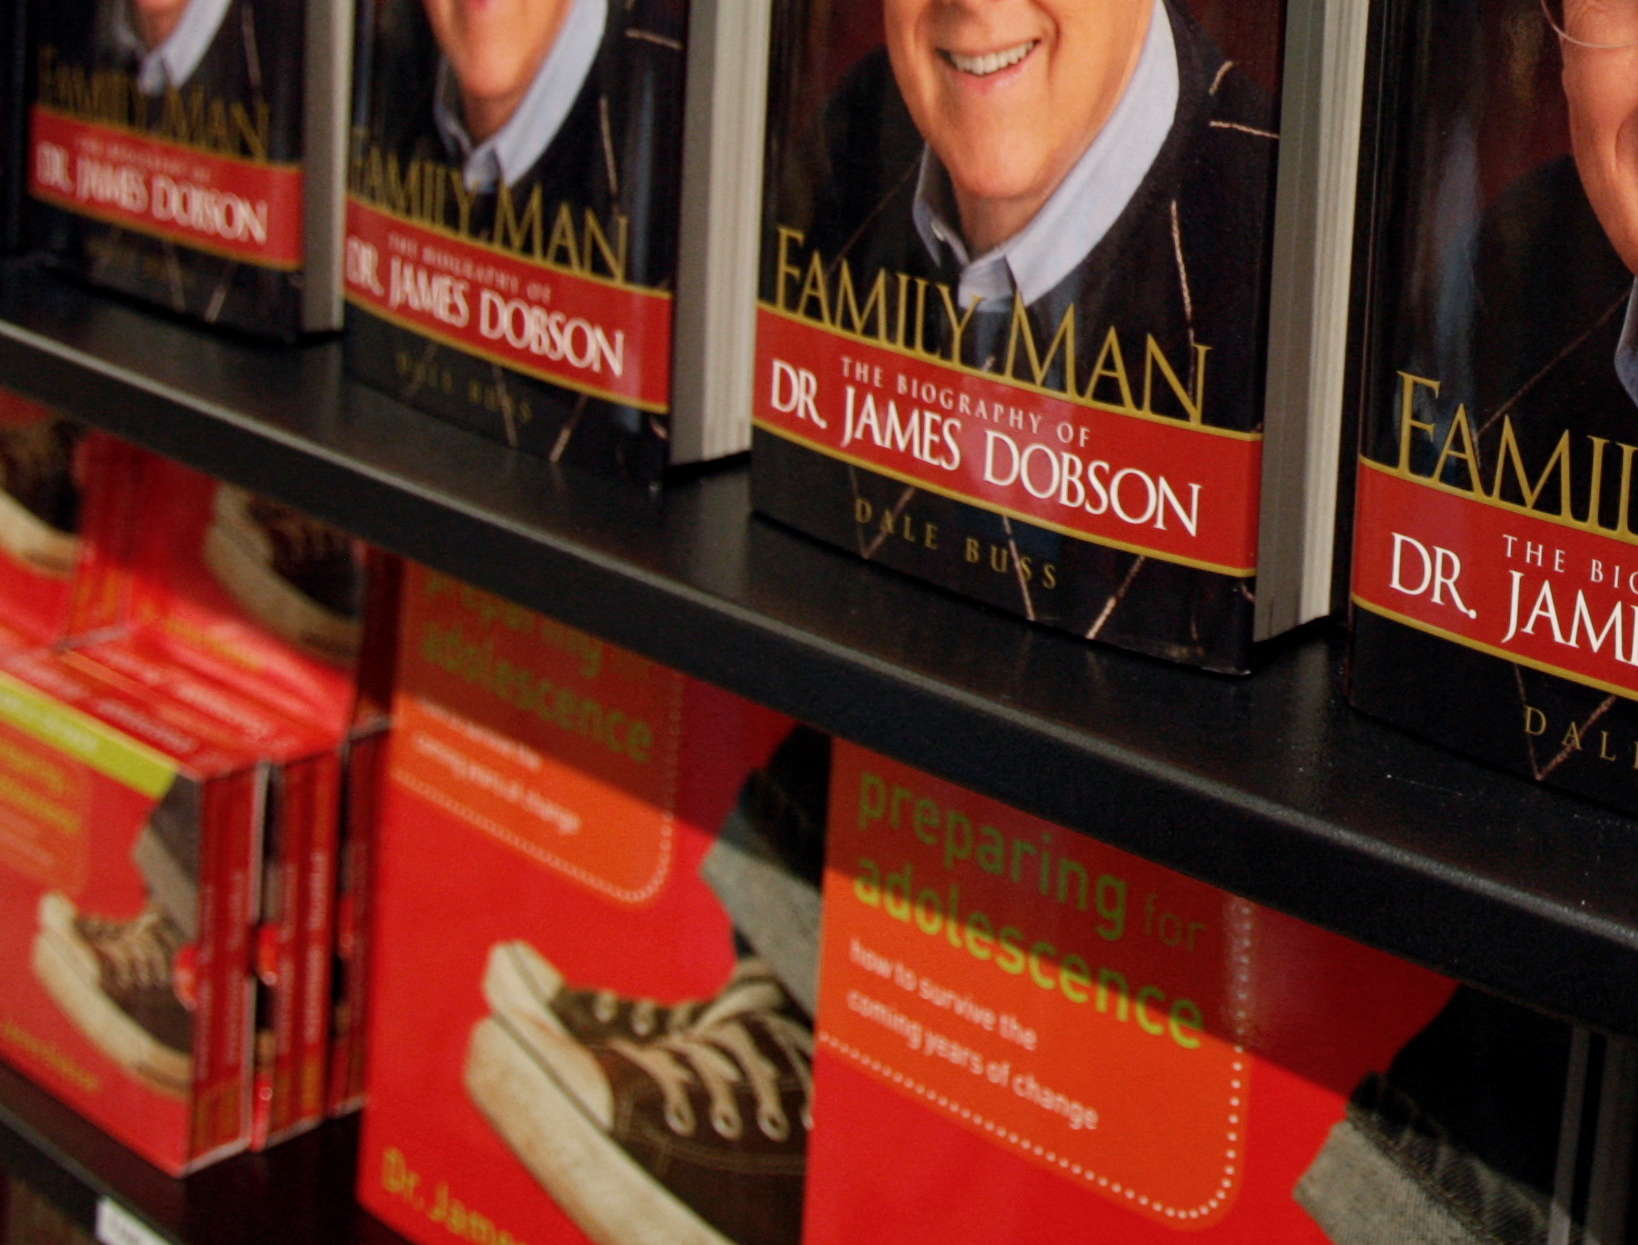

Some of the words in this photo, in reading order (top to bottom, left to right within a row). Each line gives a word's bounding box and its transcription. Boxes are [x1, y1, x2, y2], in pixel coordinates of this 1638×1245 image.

[493, 177, 628, 285] MAN
[389, 256, 470, 329] JAMES
[480, 288, 625, 378] DOBSON
[775, 225, 983, 369] FAMILY
[1004, 290, 1212, 425] MAN
[840, 355, 885, 389] THE
[896, 372, 1044, 435] BIOGRAPHY
[1056, 421, 1091, 449] OF
[840, 385, 963, 472] JAMES
[982, 429, 1202, 538] DOBSON
[853, 496, 940, 552] DALE
[964, 536, 1059, 591] BUSS
[1388, 531, 1478, 621] DR.
[1502, 533, 1567, 574] THE
[857, 770, 1128, 942] preparing
[1144, 890, 1209, 953] for
[853, 857, 1205, 1051] adolescence
[846, 988, 924, 1051] coming
[923, 1028, 985, 1077] years
[1011, 1073, 1099, 1132] change
[917, 976, 997, 1033] survive
[998, 1011, 1038, 1052] the
